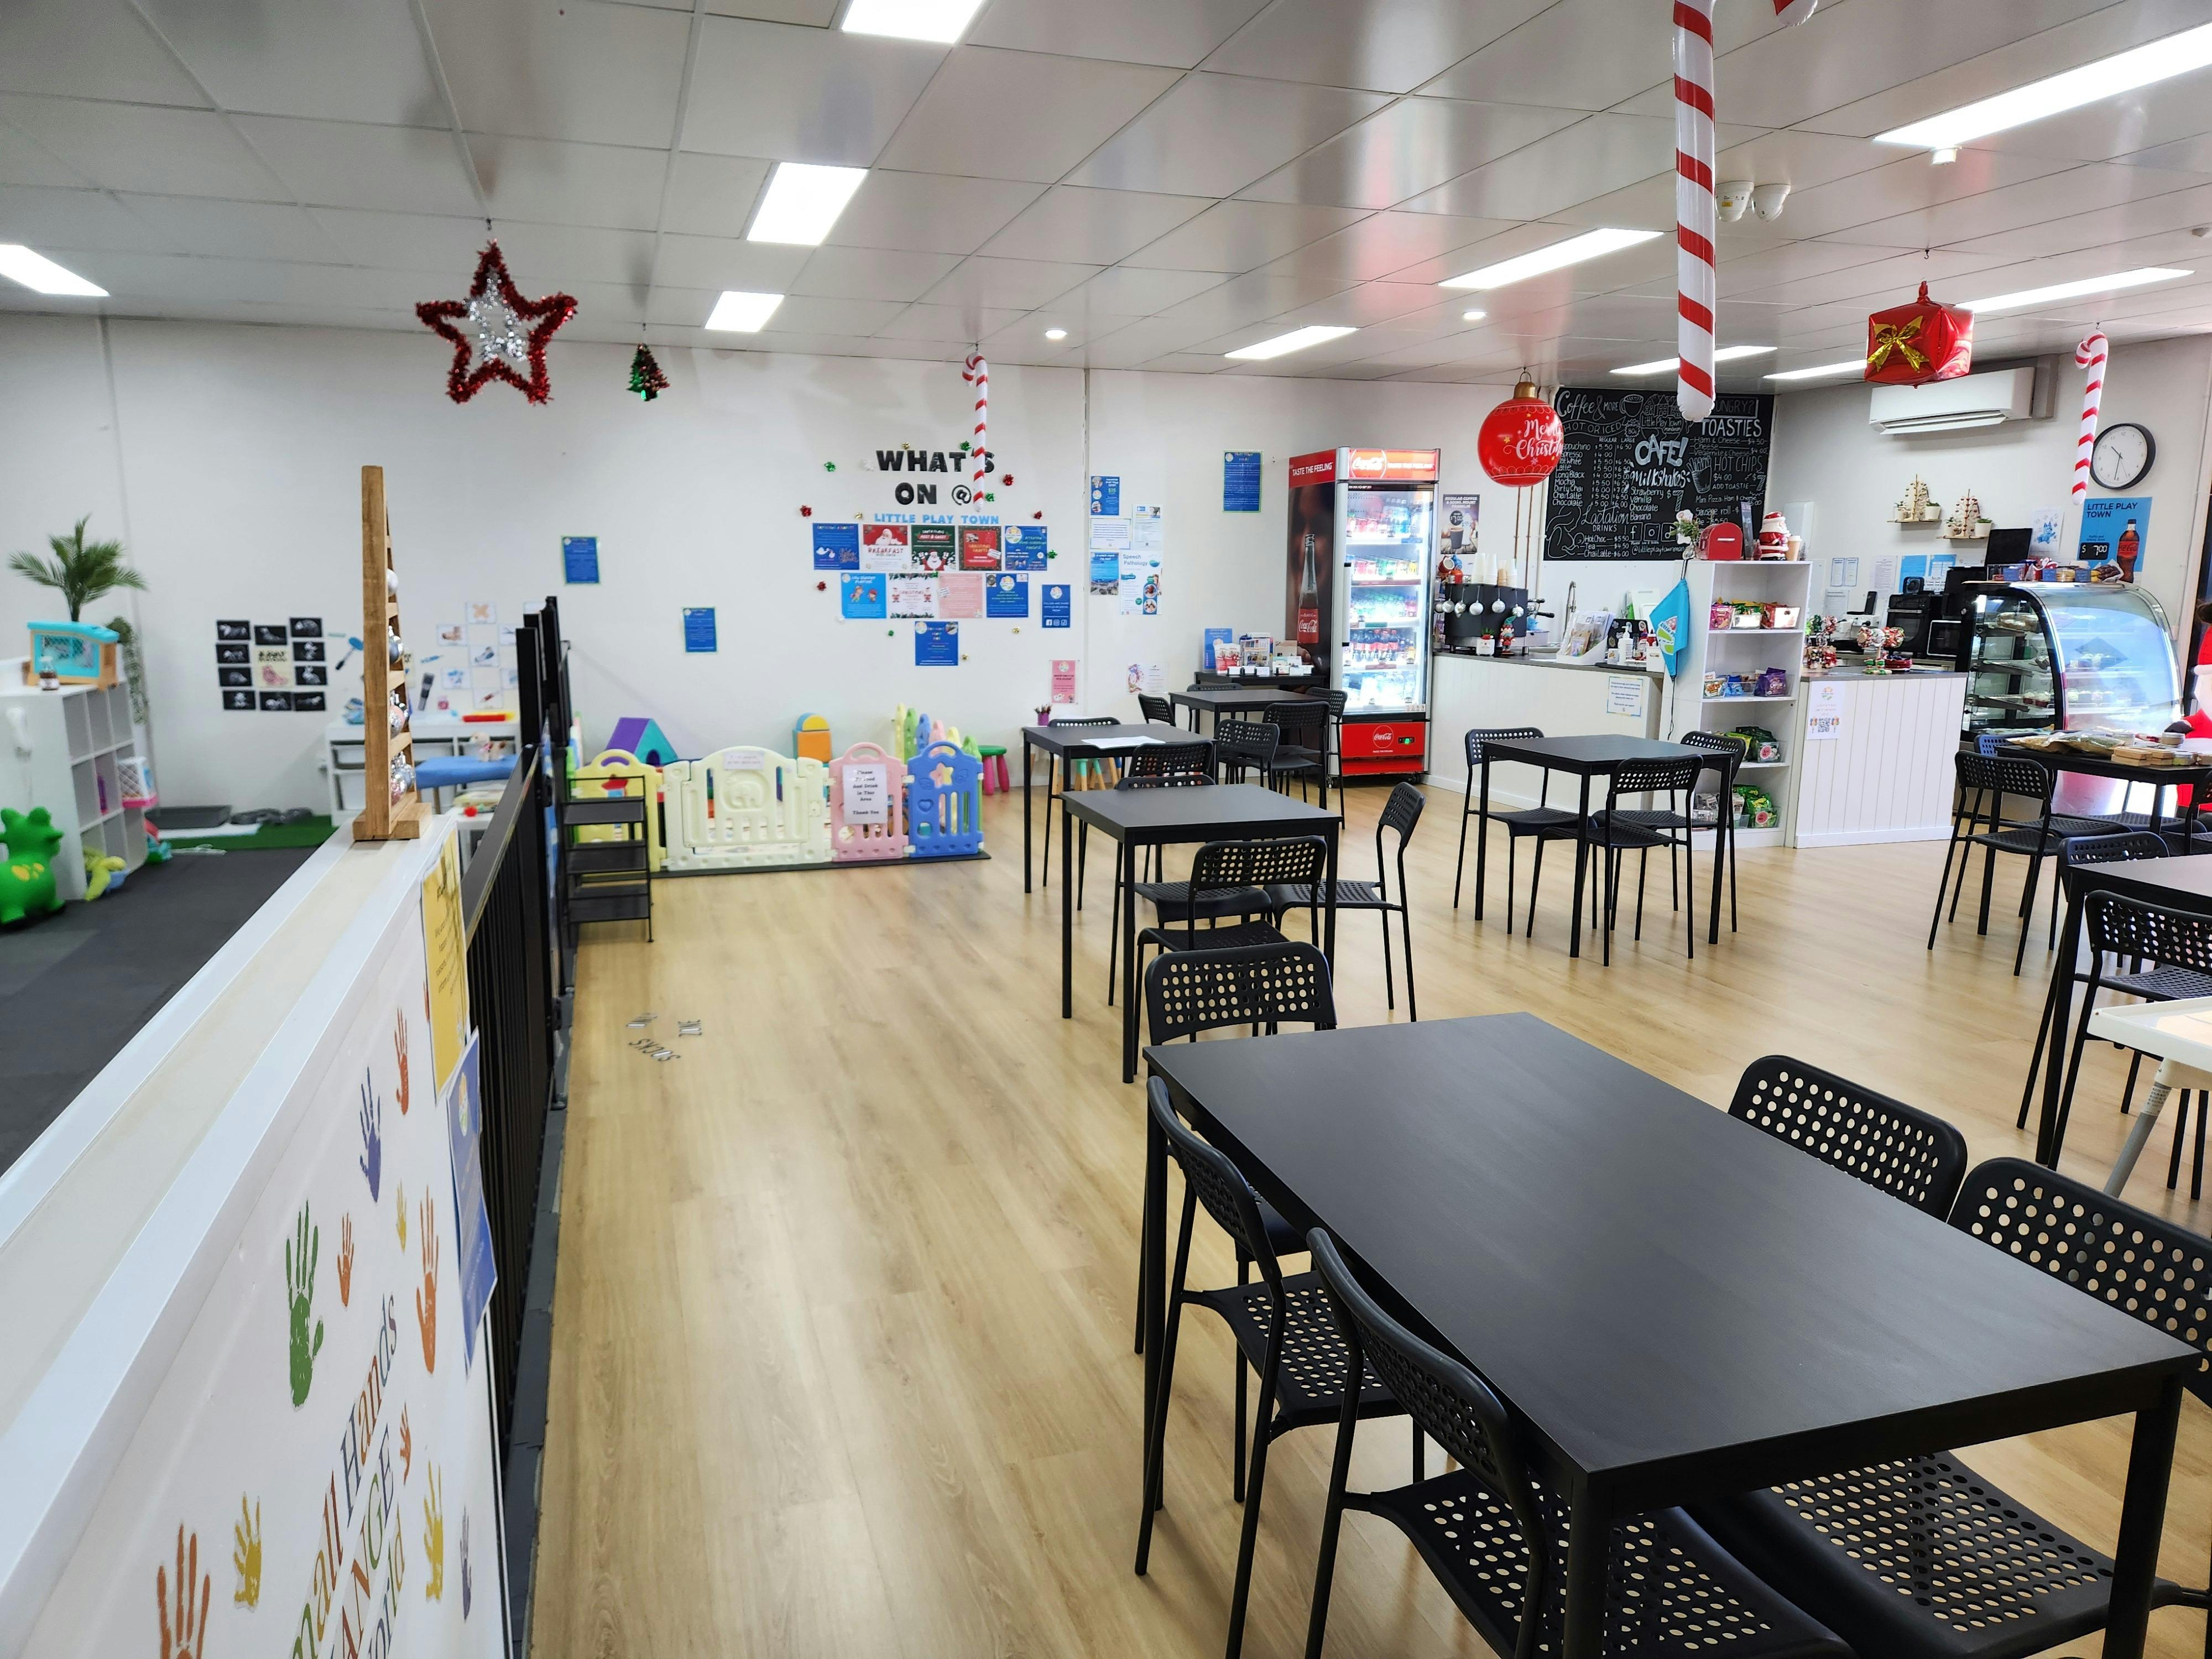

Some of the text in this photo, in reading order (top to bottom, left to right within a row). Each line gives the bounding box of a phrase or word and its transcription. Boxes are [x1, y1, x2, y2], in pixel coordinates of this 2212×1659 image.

[1557, 390, 1619, 421] Coffee & MORE
[1641, 415, 1655, 426] Little
[1667, 417, 1681, 426] Town
[1564, 422, 1622, 434] HOT OR ICED
[1702, 418, 1762, 437] TOASTIES
[1635, 433, 1689, 467] CAFE!
[1292, 466, 1305, 476] TASTE
[1313, 463, 1333, 473] FEELING
[1714, 456, 1763, 472] HOT CHIPS
[1555, 471, 1569, 479] Long
[1569, 470, 1585, 478] Black
[895, 482, 972, 505] ON @
[1630, 486, 1664, 499] Strawberry
[1581, 502, 1630, 525] Lactation
[1629, 503, 1658, 512] Chocolate
[1695, 507, 1718, 517] Sausage
[1720, 505, 1731, 515] roll
[874, 513, 999, 524] LITTLE PLAY TOWN
[1630, 511, 1651, 520] Banana
[1584, 549, 1597, 557] Chai
[1597, 549, 1612, 557] Latte
[339, 1293, 398, 1528] Hands
